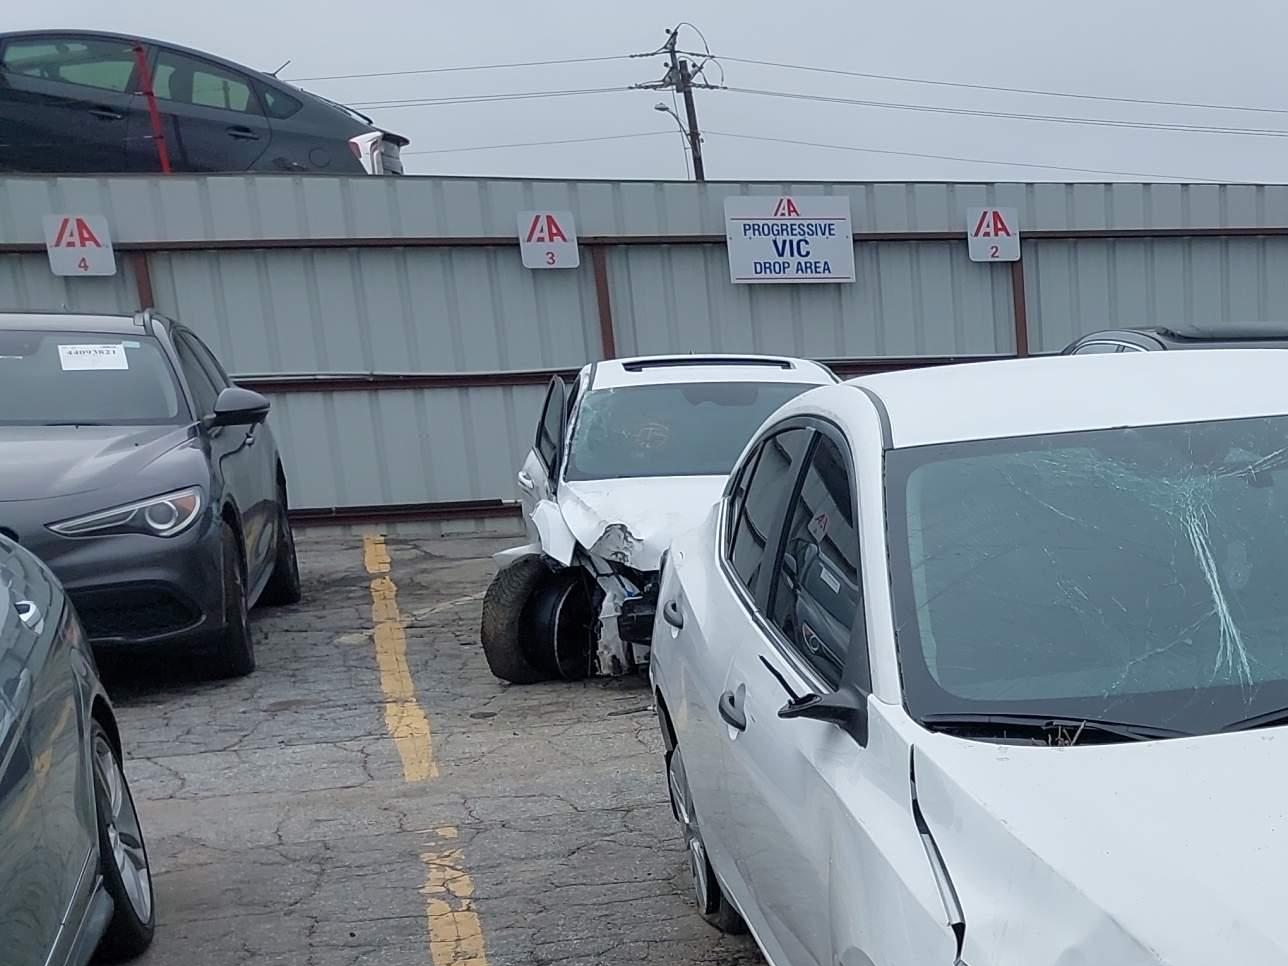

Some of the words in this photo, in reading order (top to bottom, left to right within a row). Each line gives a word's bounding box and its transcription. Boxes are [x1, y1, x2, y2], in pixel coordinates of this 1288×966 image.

[743, 223, 836, 237] PROGRESSIVE
[772, 239, 811, 258] VIC
[990, 245, 1000, 258] 2
[78, 257, 89, 272] 4
[545, 251, 556, 266] 3
[754, 261, 791, 275] DROP
[795, 261, 832, 275] AREA
